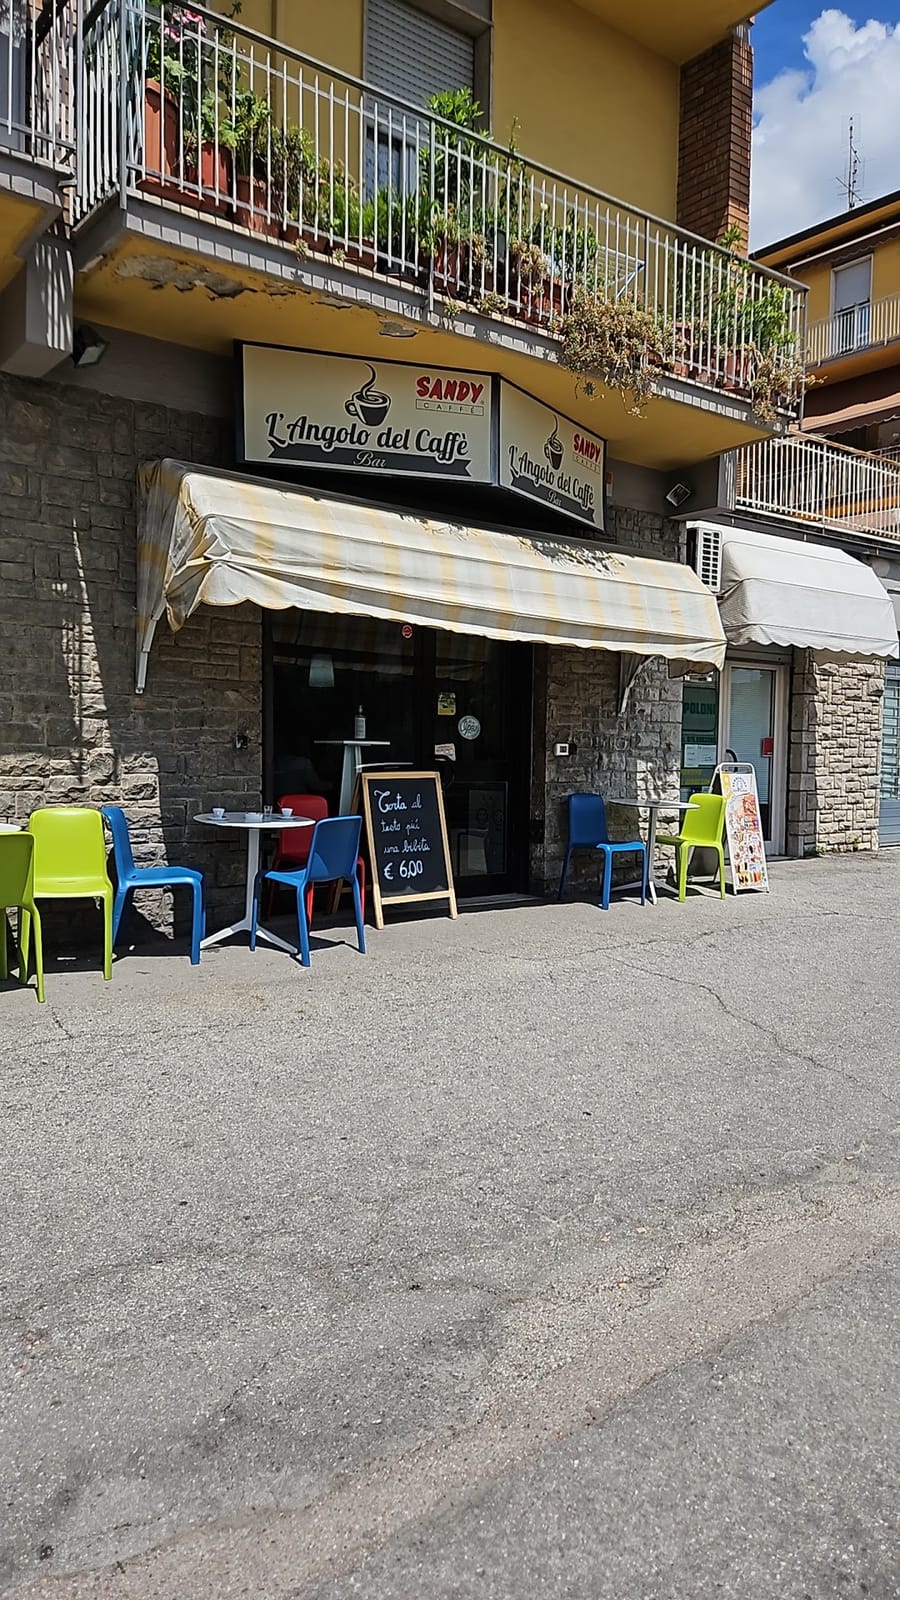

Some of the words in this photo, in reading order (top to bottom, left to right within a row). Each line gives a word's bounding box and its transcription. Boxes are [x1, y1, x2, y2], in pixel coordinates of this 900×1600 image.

[416, 376, 484, 404] SANDY
[265, 412, 371, 449] L'Angolo
[376, 426, 410, 450] del
[415, 428, 469, 461] Caffè
[573, 433, 600, 463] SANDY
[353, 450, 386, 468] Bar
[508, 445, 555, 486] L'Angolo
[557, 472, 571, 494] del
[572, 478, 594, 508] Caffè
[547, 490, 562, 507] Bar
[373, 789, 408, 813] Torta
[411, 793, 422, 809] al
[384, 845, 400, 854] una
[401, 838, 431, 854] bibita
[384, 862, 394, 880] €
[399, 859, 423, 879] 6,00
